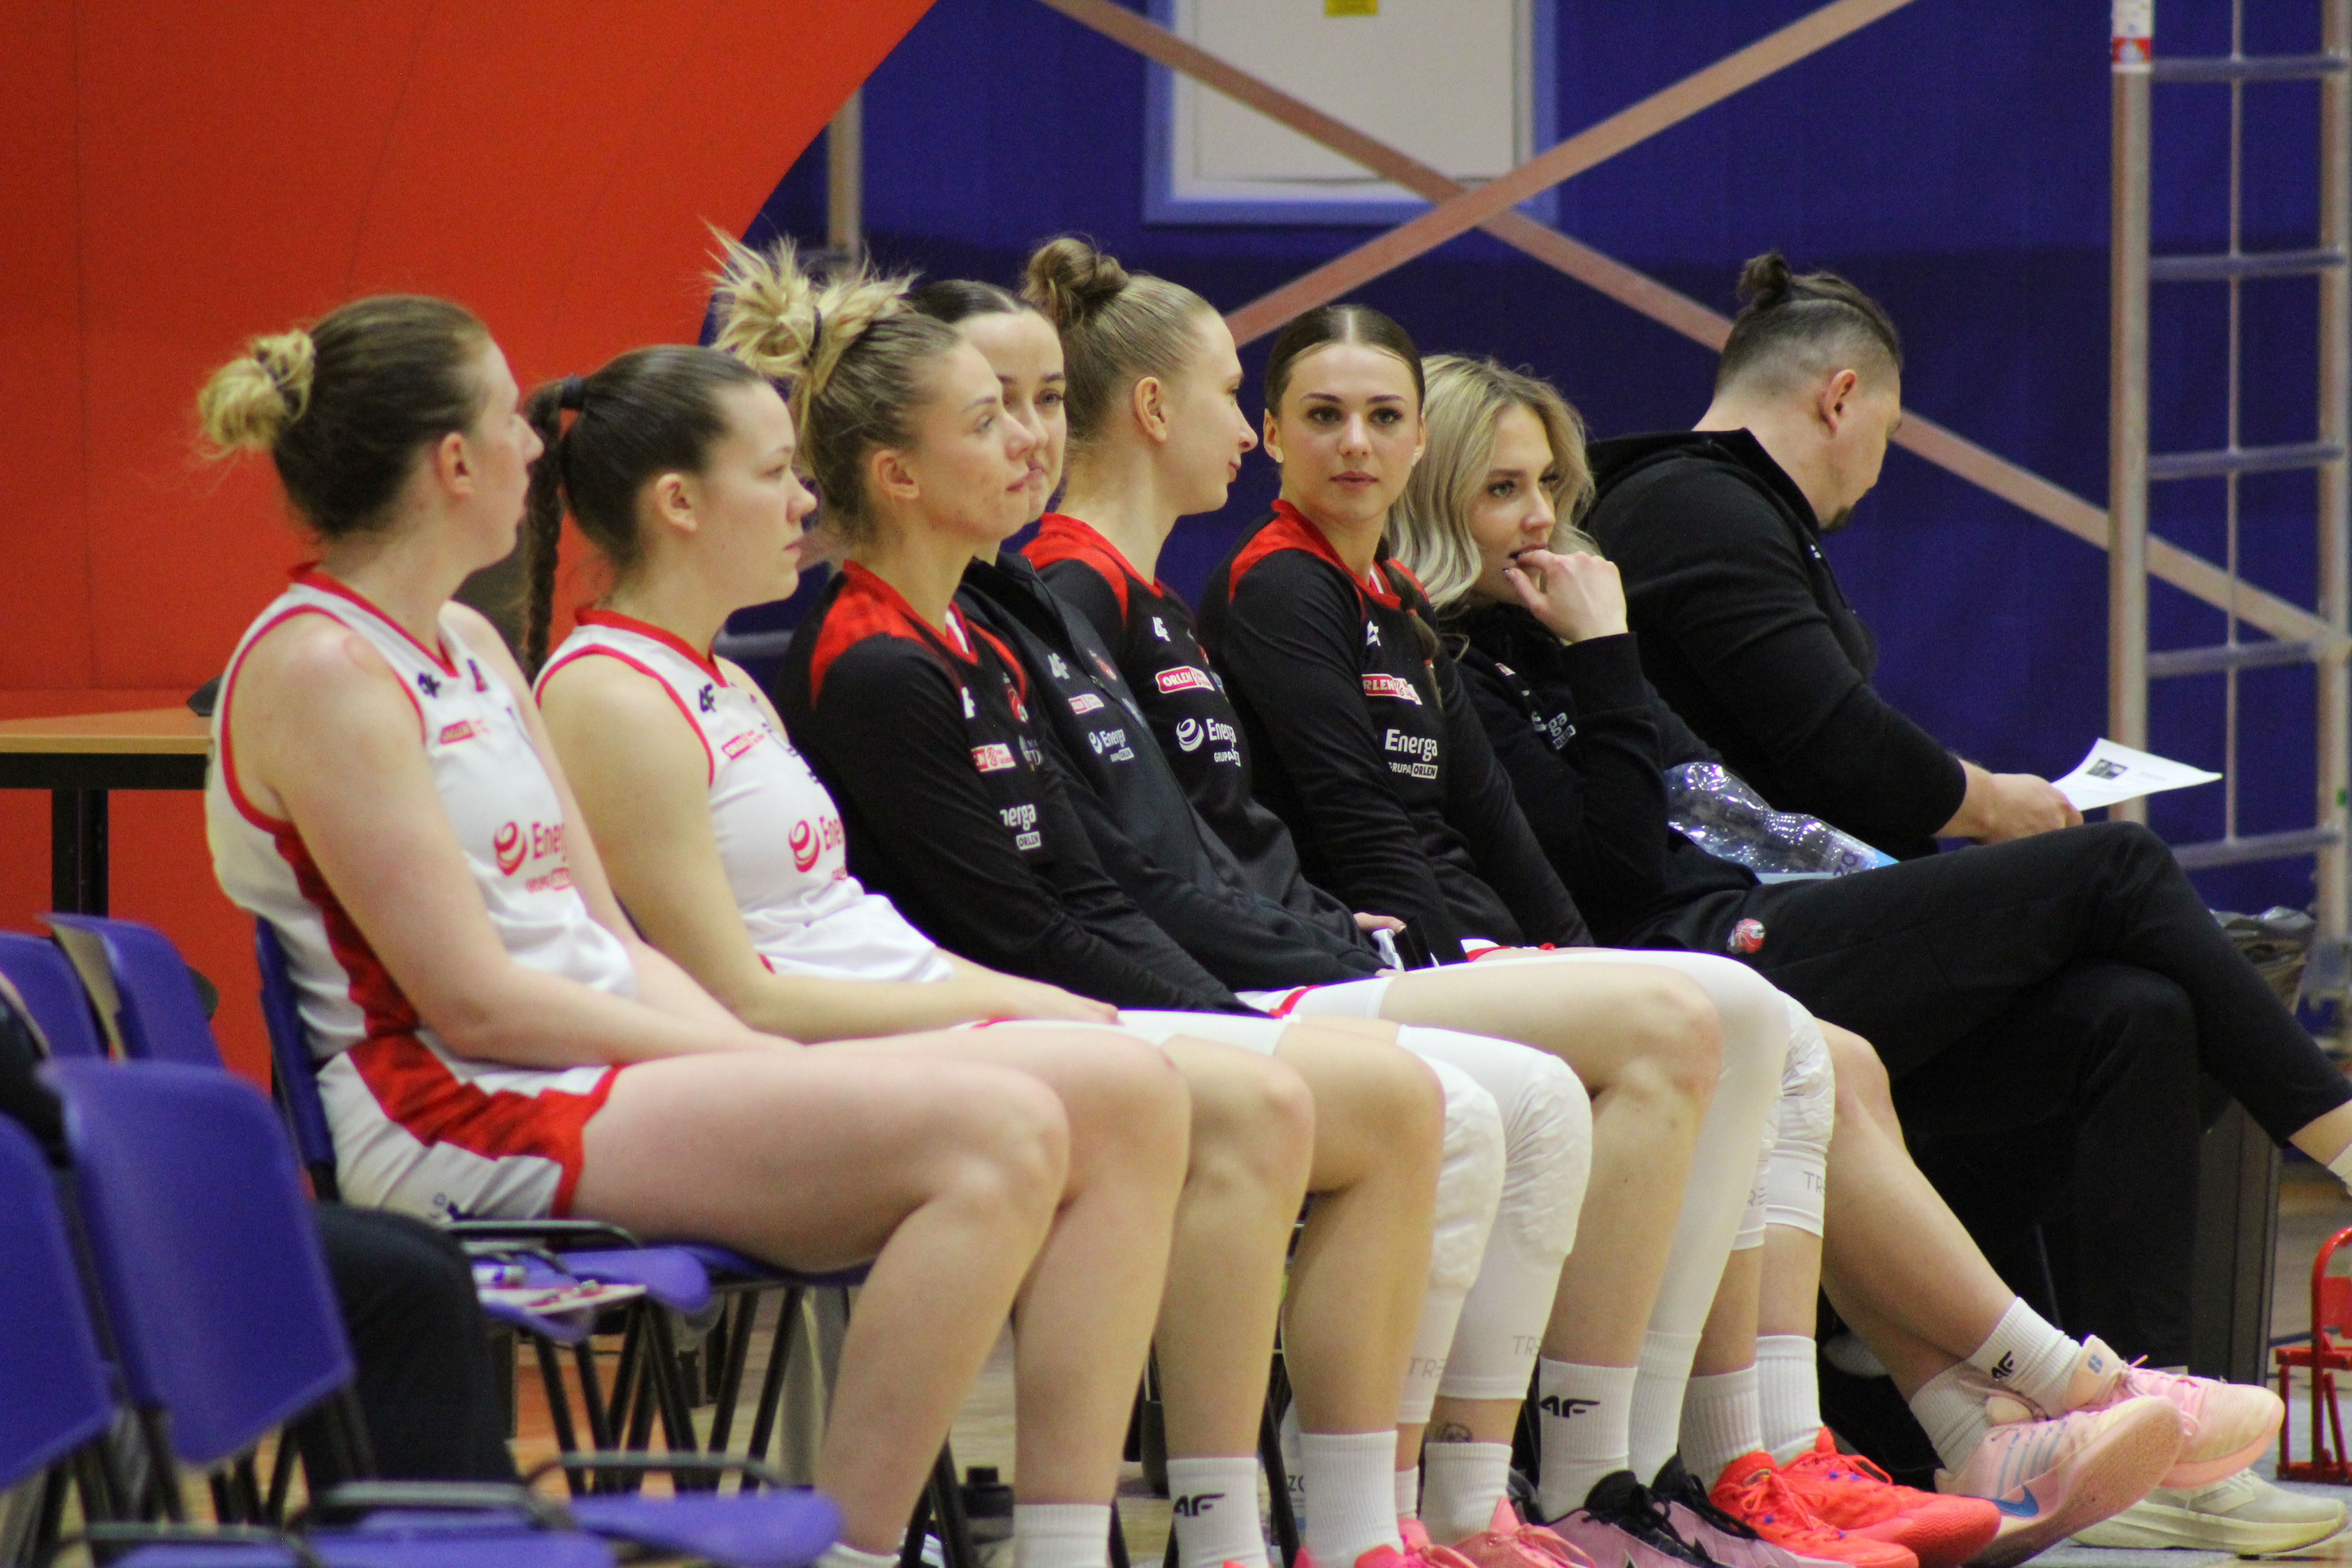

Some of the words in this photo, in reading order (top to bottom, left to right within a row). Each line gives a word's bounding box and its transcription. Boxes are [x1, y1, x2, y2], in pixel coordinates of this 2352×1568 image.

[1162, 671, 1194, 687] ORLEN
[1362, 679, 1395, 691] RLEN
[1384, 728, 1438, 762] Energa
[1413, 765, 1436, 777] ORLEN
[999, 804, 1037, 831] nerga
[1540, 1395, 1601, 1418] 4F
[1173, 1493, 1226, 1517] 4F
